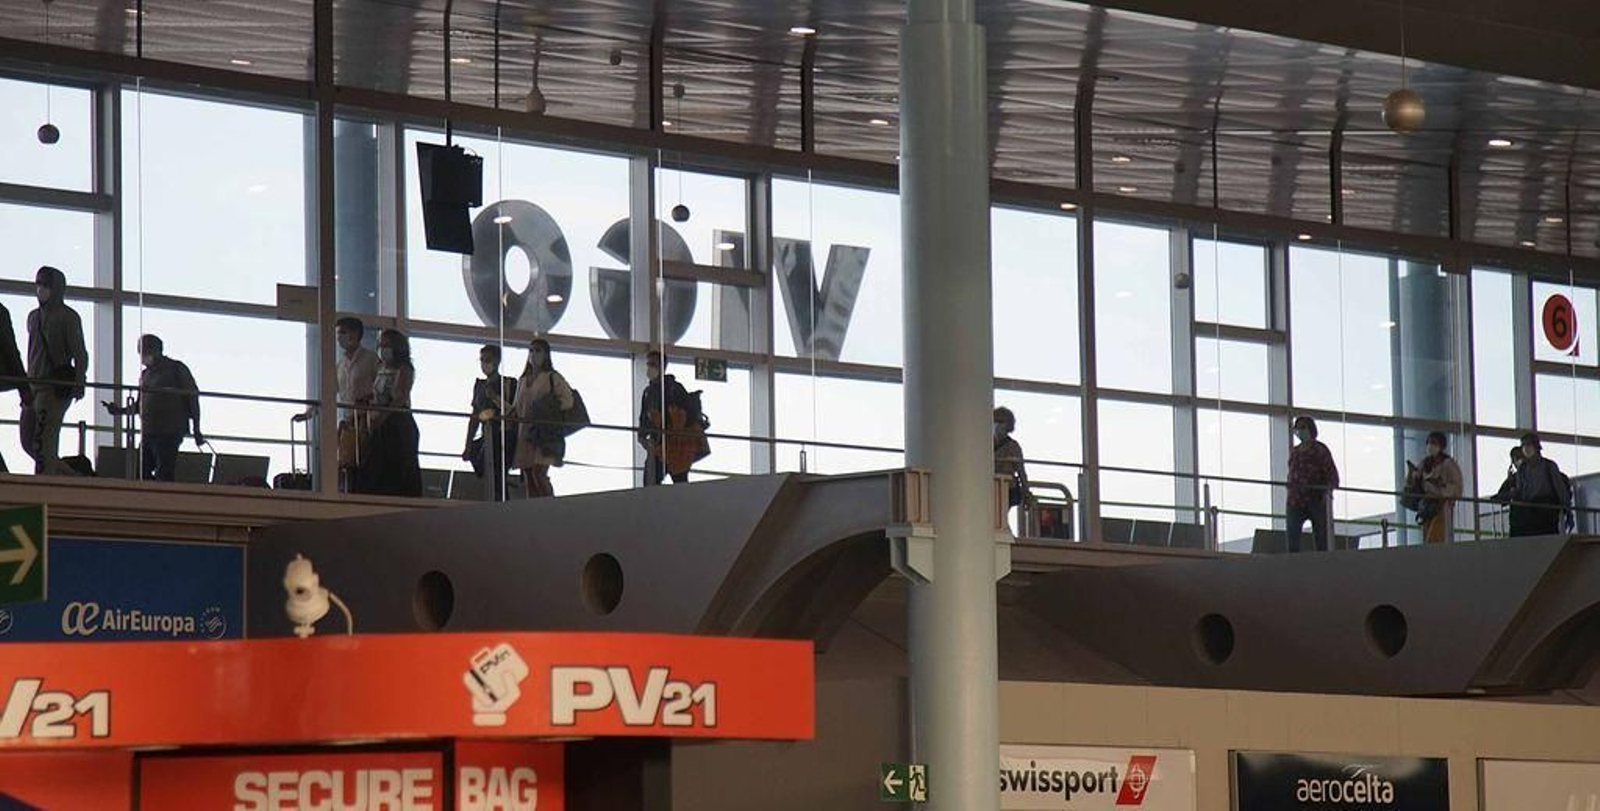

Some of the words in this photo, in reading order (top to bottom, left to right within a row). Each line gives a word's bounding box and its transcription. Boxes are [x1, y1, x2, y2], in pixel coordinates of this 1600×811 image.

[1552, 305, 1567, 338] 6
[551, 666, 717, 726] PV21
[233, 768, 433, 811] SECURE
[459, 766, 538, 811] BAG
